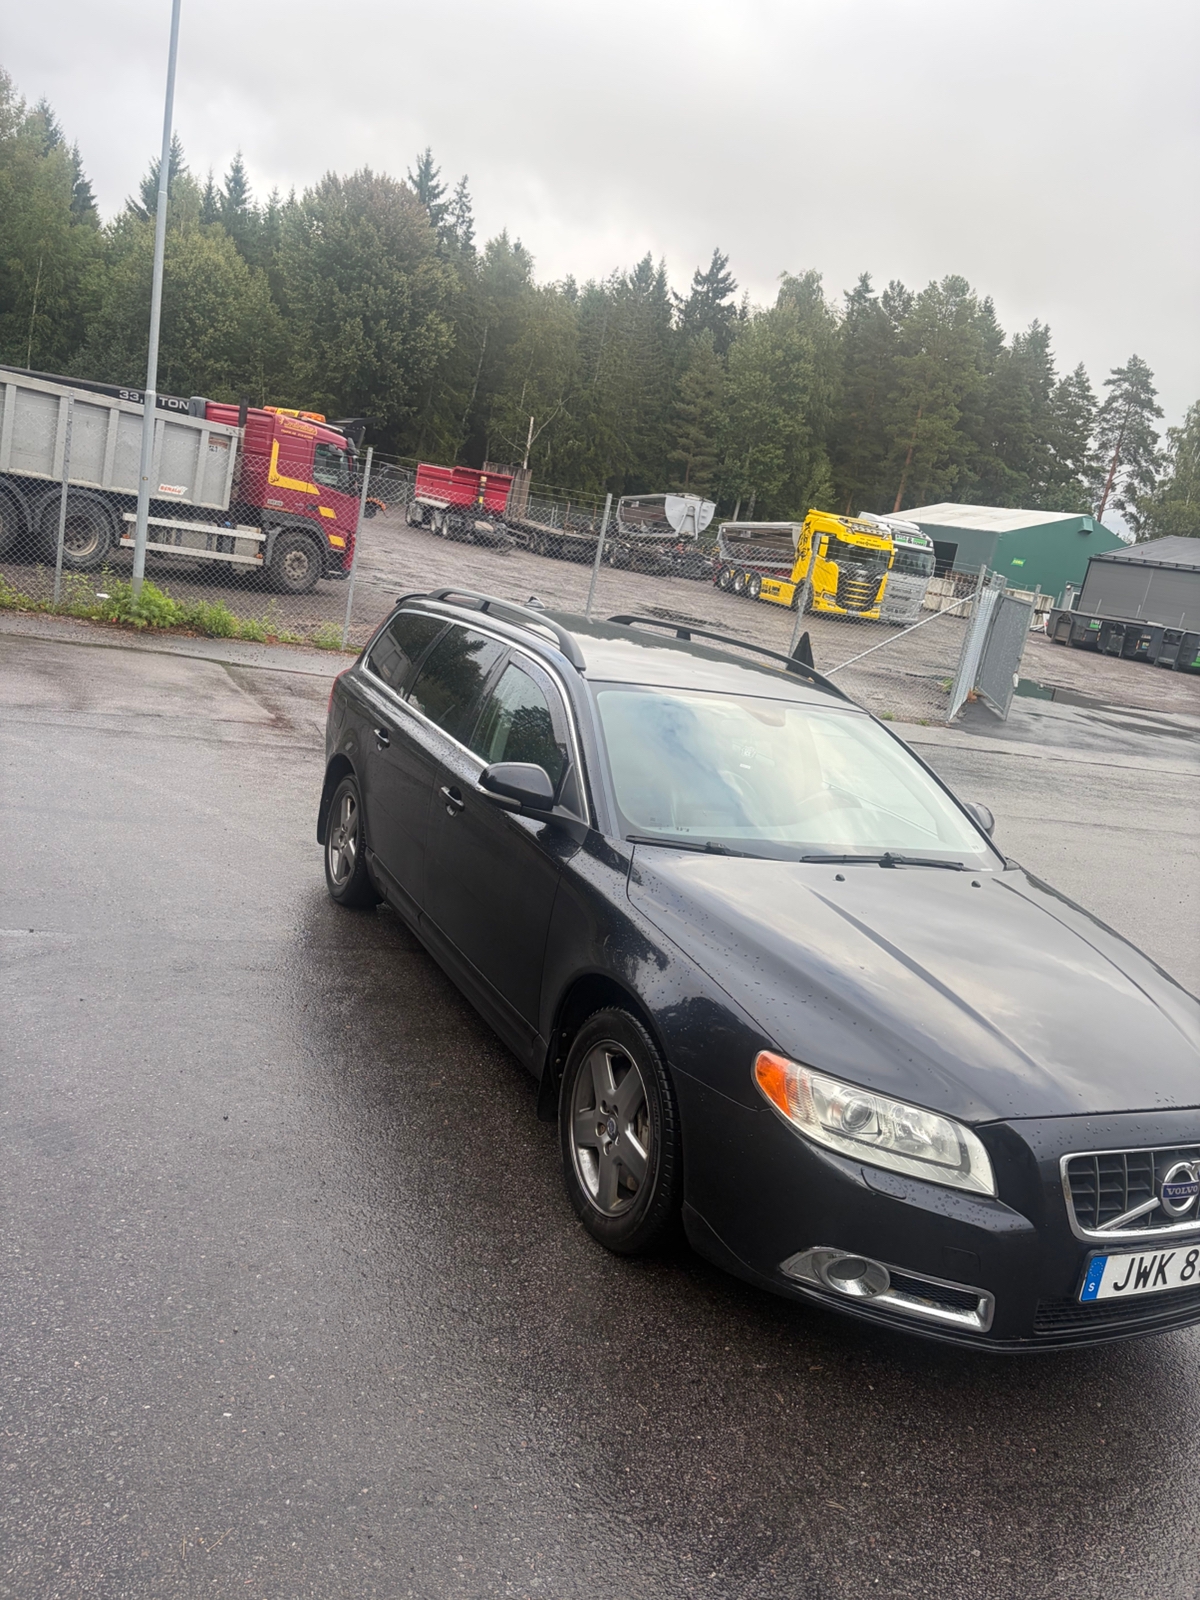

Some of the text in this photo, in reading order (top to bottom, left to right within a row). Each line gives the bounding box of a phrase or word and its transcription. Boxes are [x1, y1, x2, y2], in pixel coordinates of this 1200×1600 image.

[119, 389, 190, 410] 33, TON
[1166, 1185, 1198, 1195] VOLVO
[1113, 1249, 1200, 1291] JWK 8
[1088, 1282, 1095, 1292] S
